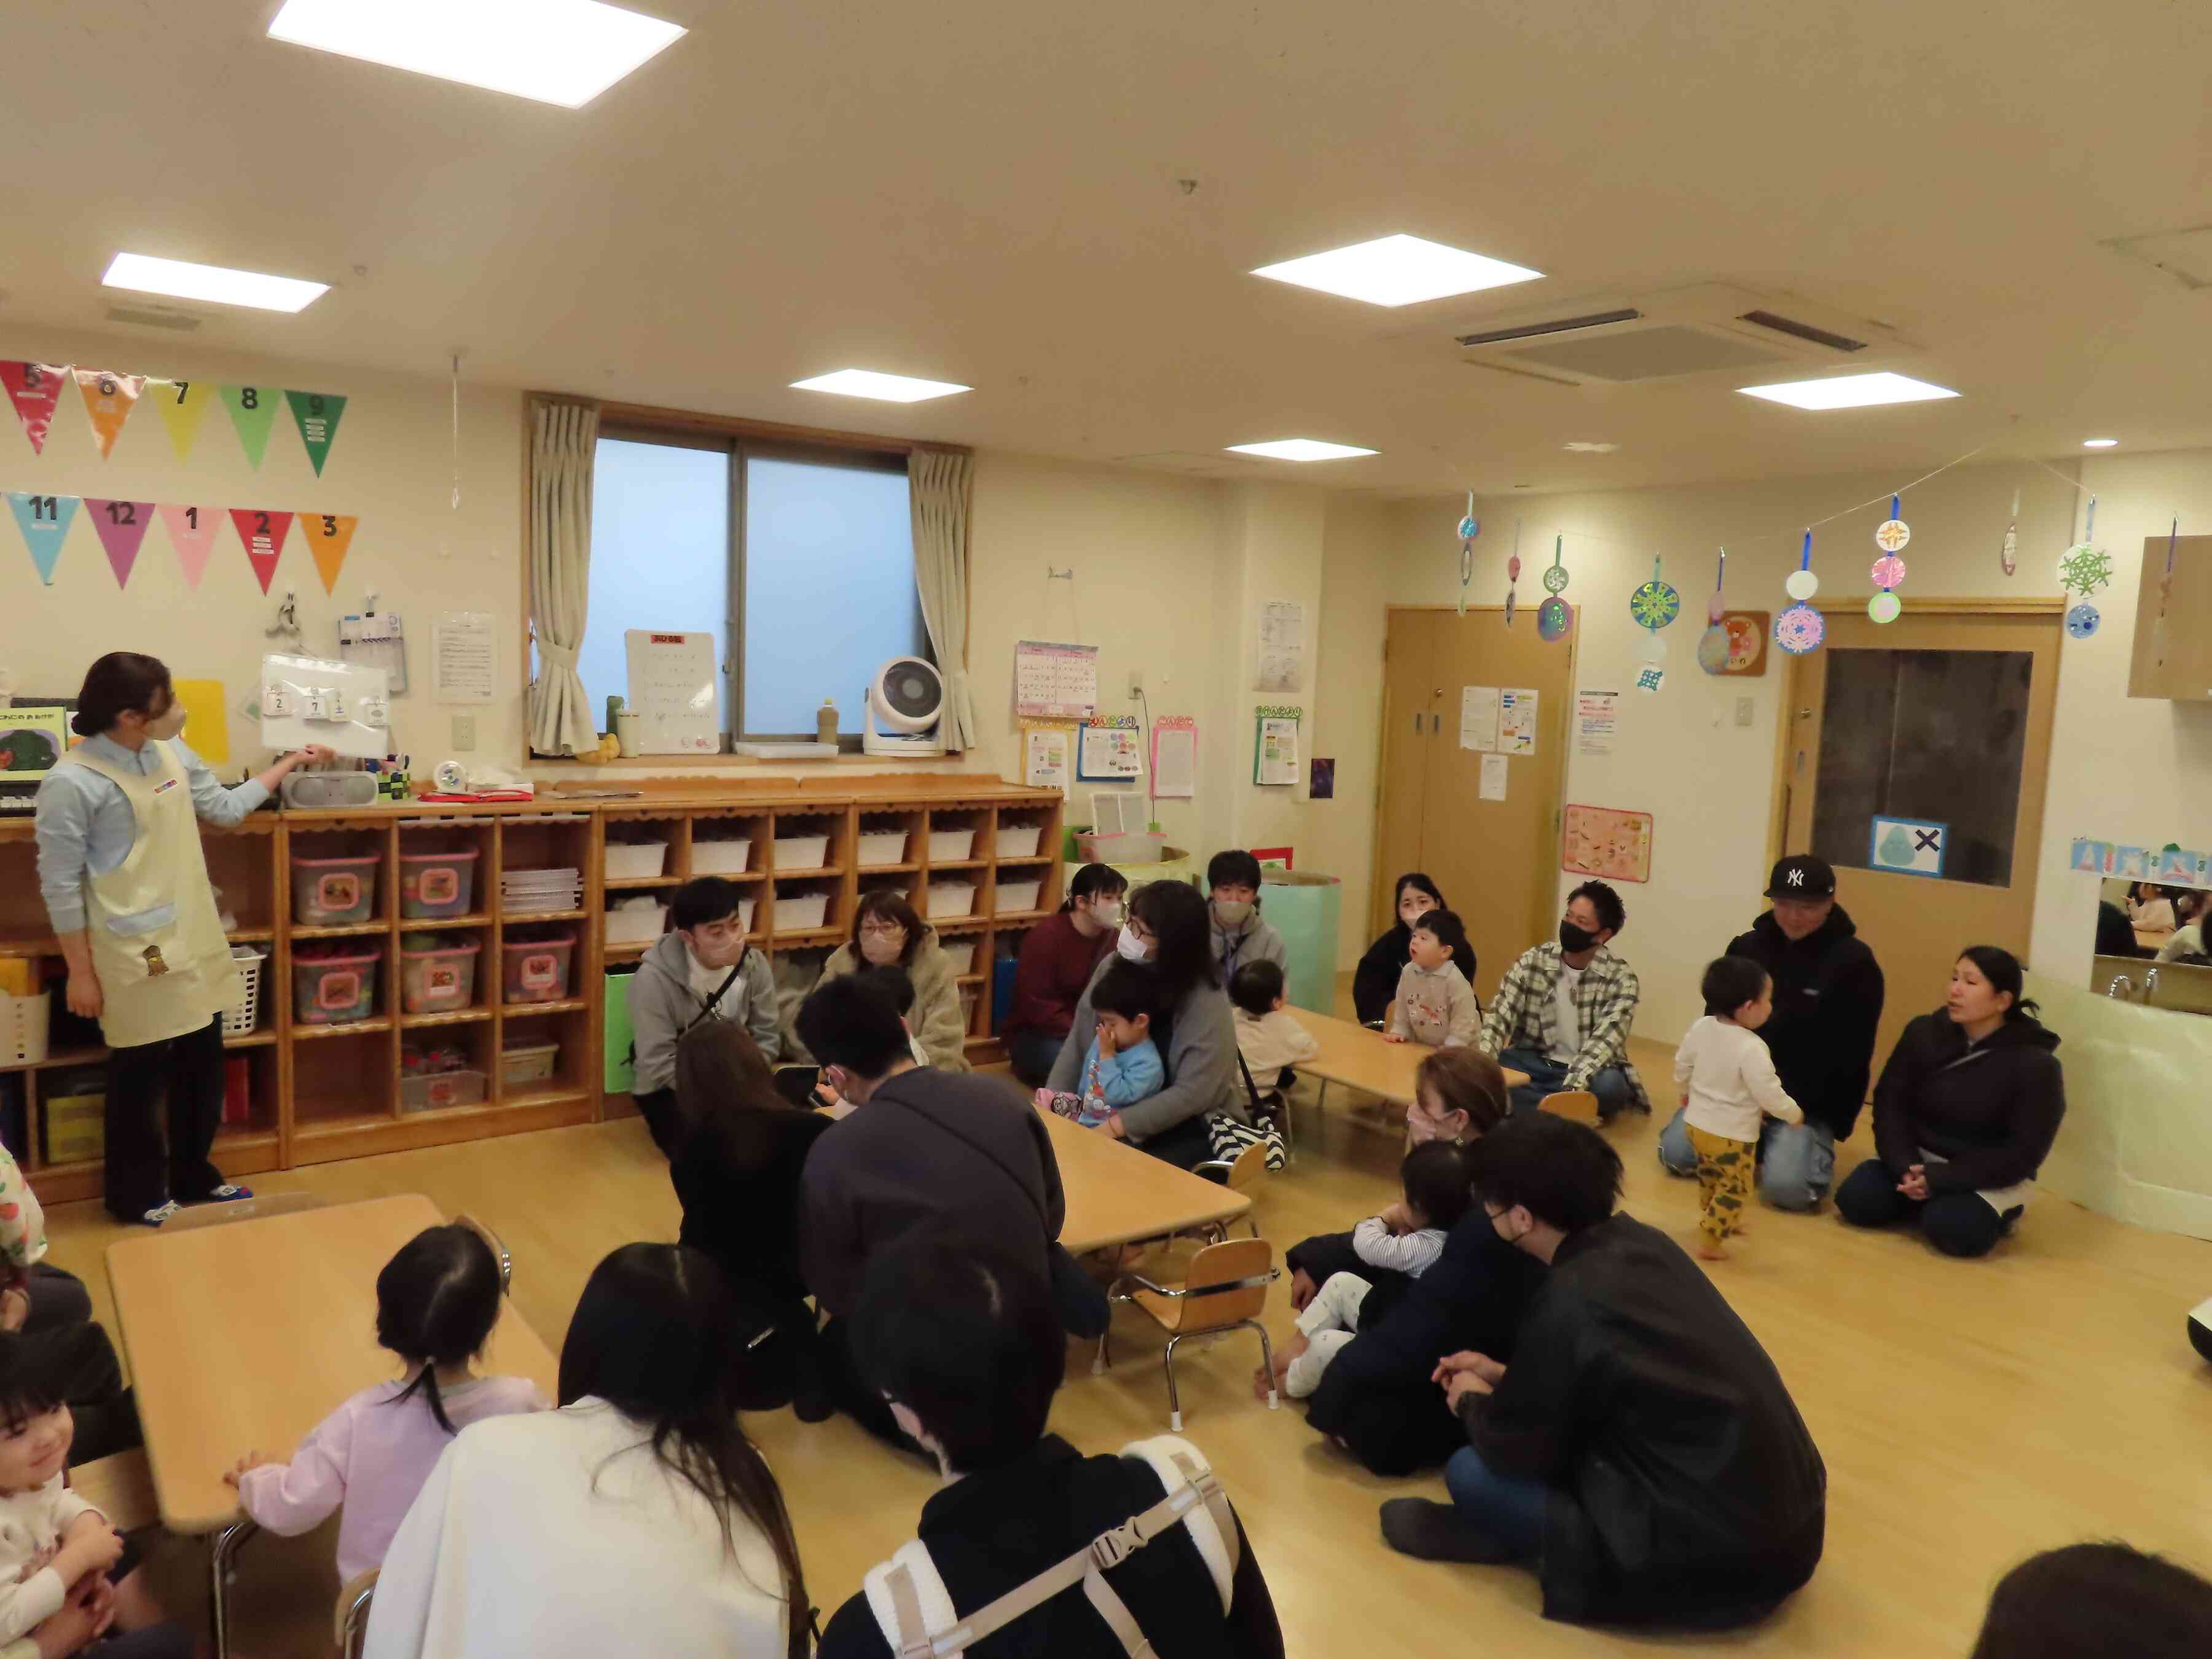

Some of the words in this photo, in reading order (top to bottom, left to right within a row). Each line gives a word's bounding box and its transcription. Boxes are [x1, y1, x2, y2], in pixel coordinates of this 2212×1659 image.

[174, 382, 188, 404] 7
[241, 388, 258, 409] 8
[308, 394, 324, 416] 9
[28, 496, 57, 520] 11
[106, 501, 136, 525] 12
[186, 507, 197, 529] 1
[254, 512, 271, 534] 2
[322, 515, 337, 537] 3
[276, 699, 283, 708] 2
[312, 702, 318, 711] 7
[1787, 868, 1805, 886] NY
